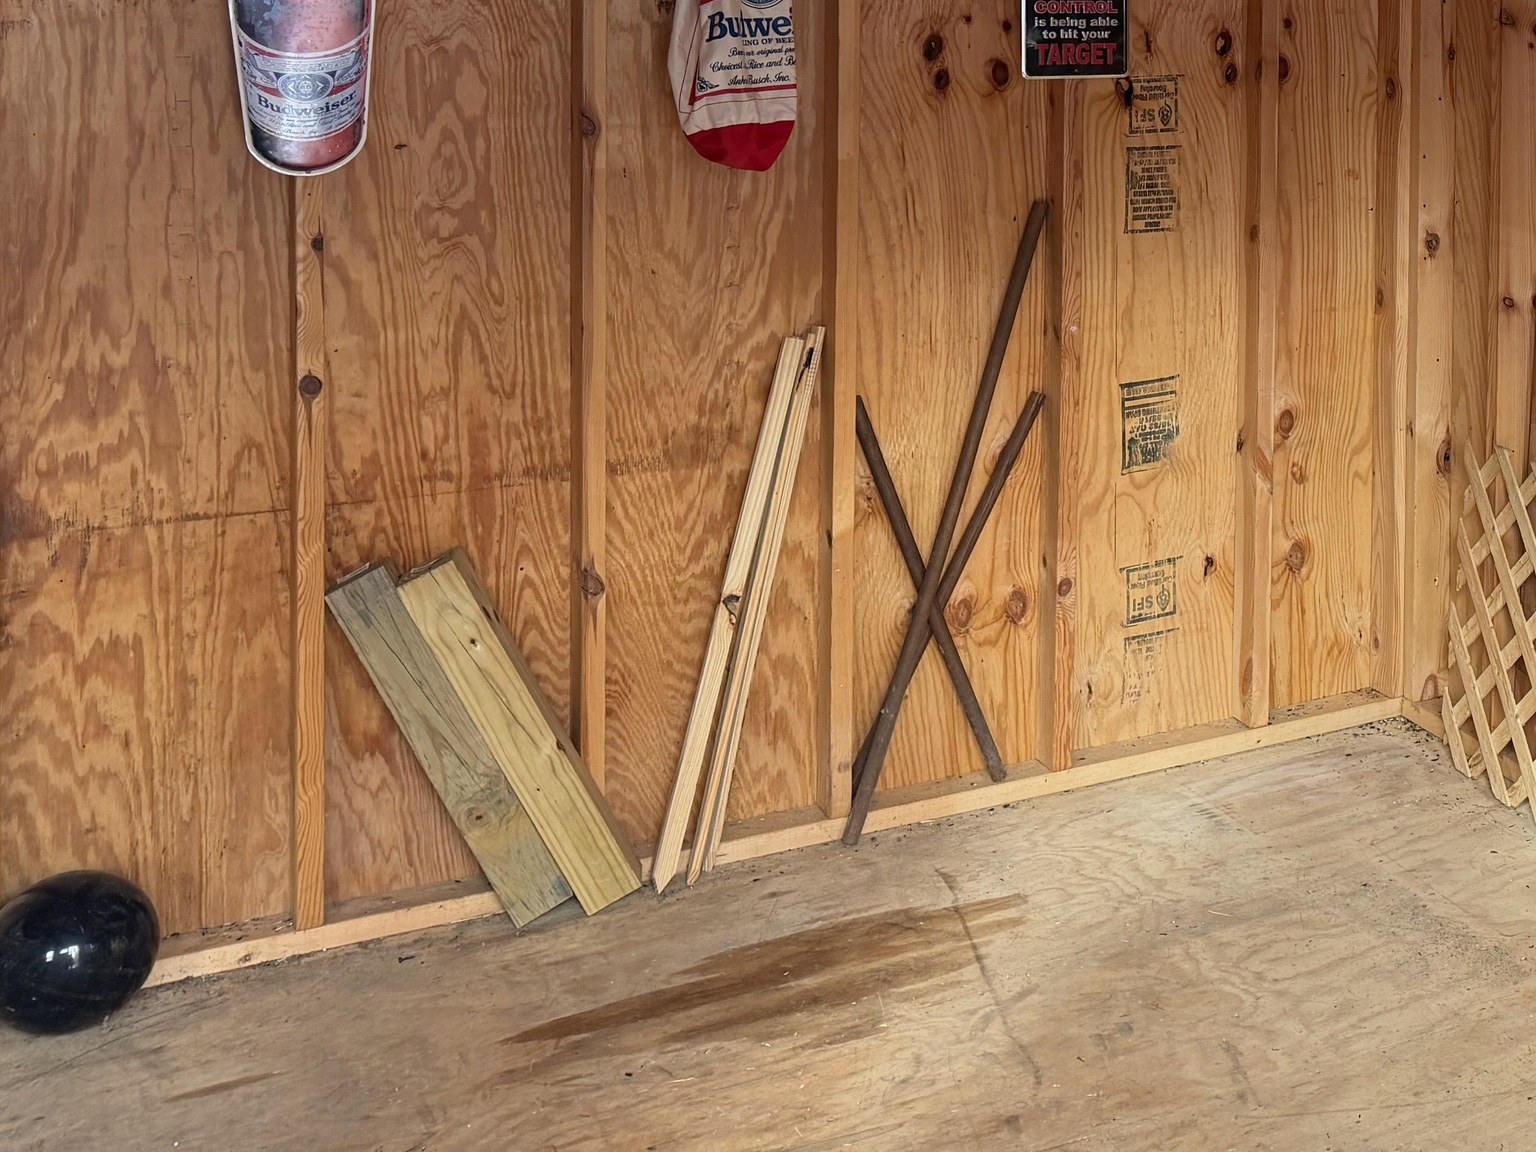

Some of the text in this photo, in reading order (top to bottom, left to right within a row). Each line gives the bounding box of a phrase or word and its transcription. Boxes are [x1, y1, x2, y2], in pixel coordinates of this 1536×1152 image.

[1033, 0, 1119, 14] CONTROL
[1034, 16, 1119, 29] is being able
[1042, 28, 1111, 42] to hit your
[1034, 42, 1118, 66] TARGET
[765, 57, 783, 68] and
[257, 90, 357, 116] Budweiser
[1132, 595, 1154, 612] SFI
